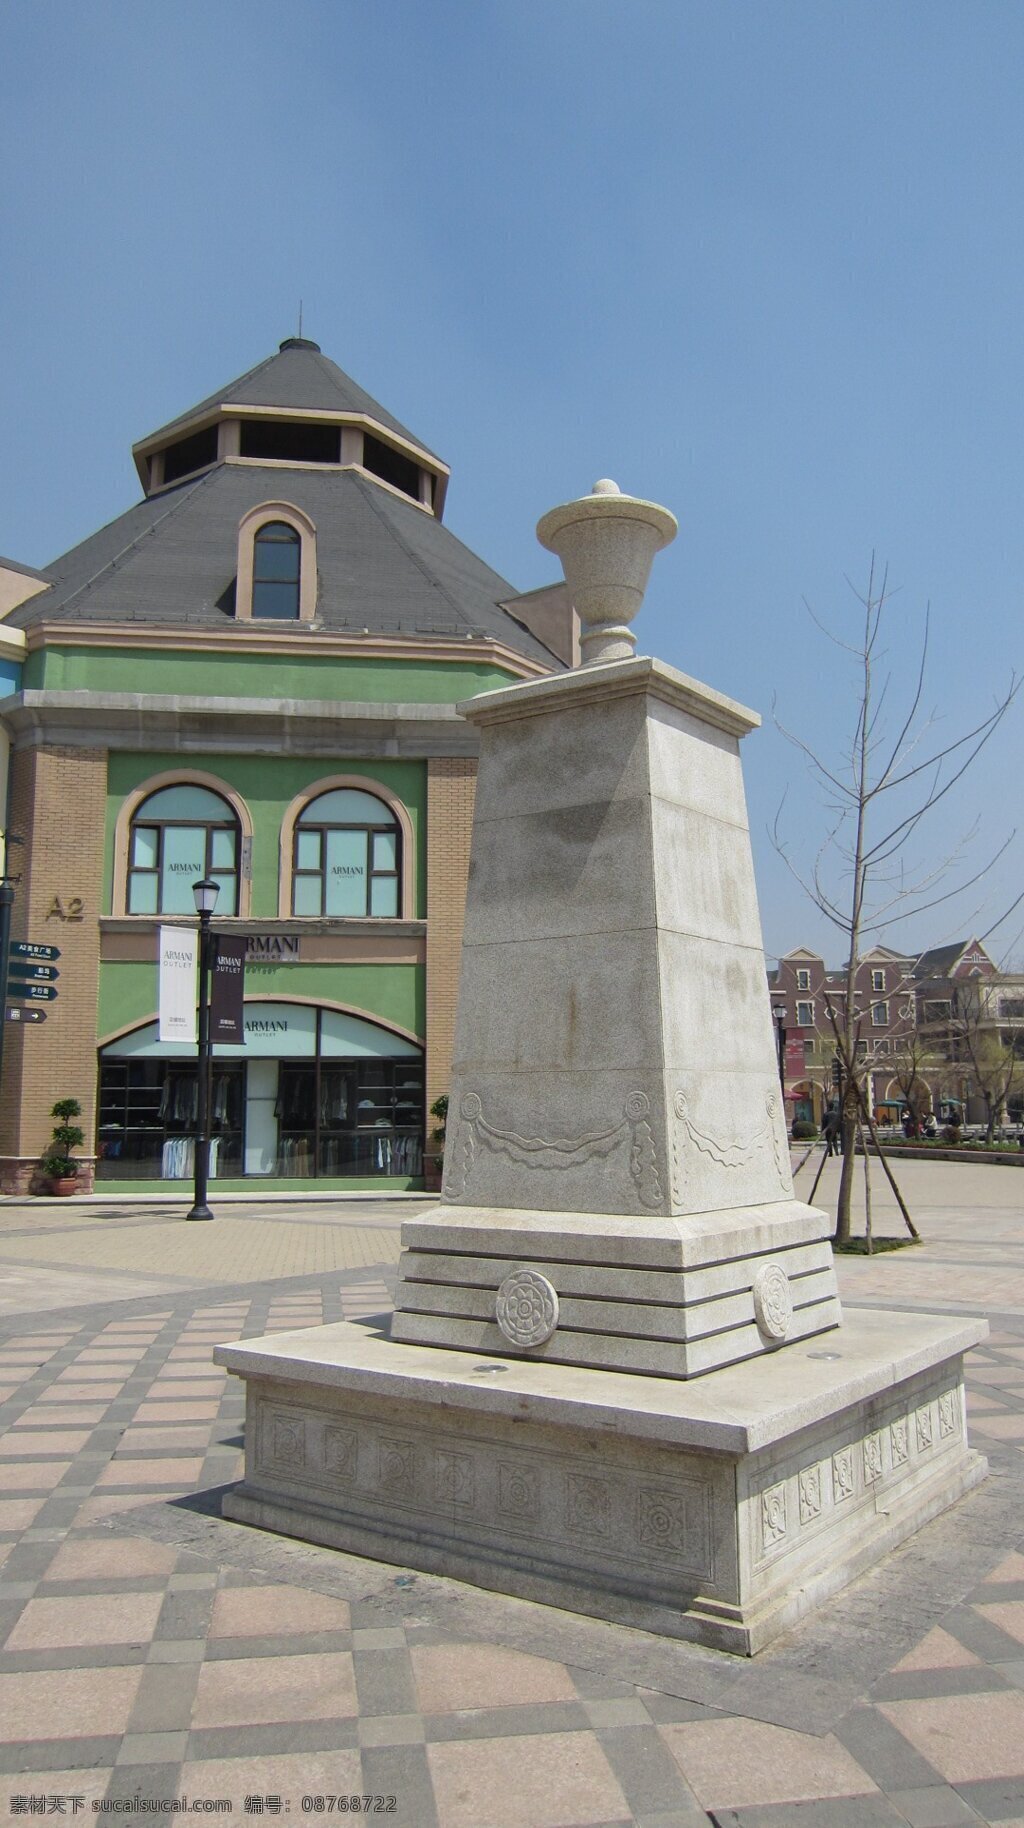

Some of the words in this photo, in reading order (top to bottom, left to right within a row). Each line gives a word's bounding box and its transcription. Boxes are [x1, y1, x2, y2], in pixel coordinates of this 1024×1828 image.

[168, 863, 202, 872] ARMANI
[331, 866, 364, 875] ARMANI
[45, 895, 84, 923] A2
[246, 936, 299, 953] RMANI
[164, 950, 192, 962] ARMANI
[163, 961, 192, 969] OUTLET
[244, 1020, 288, 1032] ARMANI
